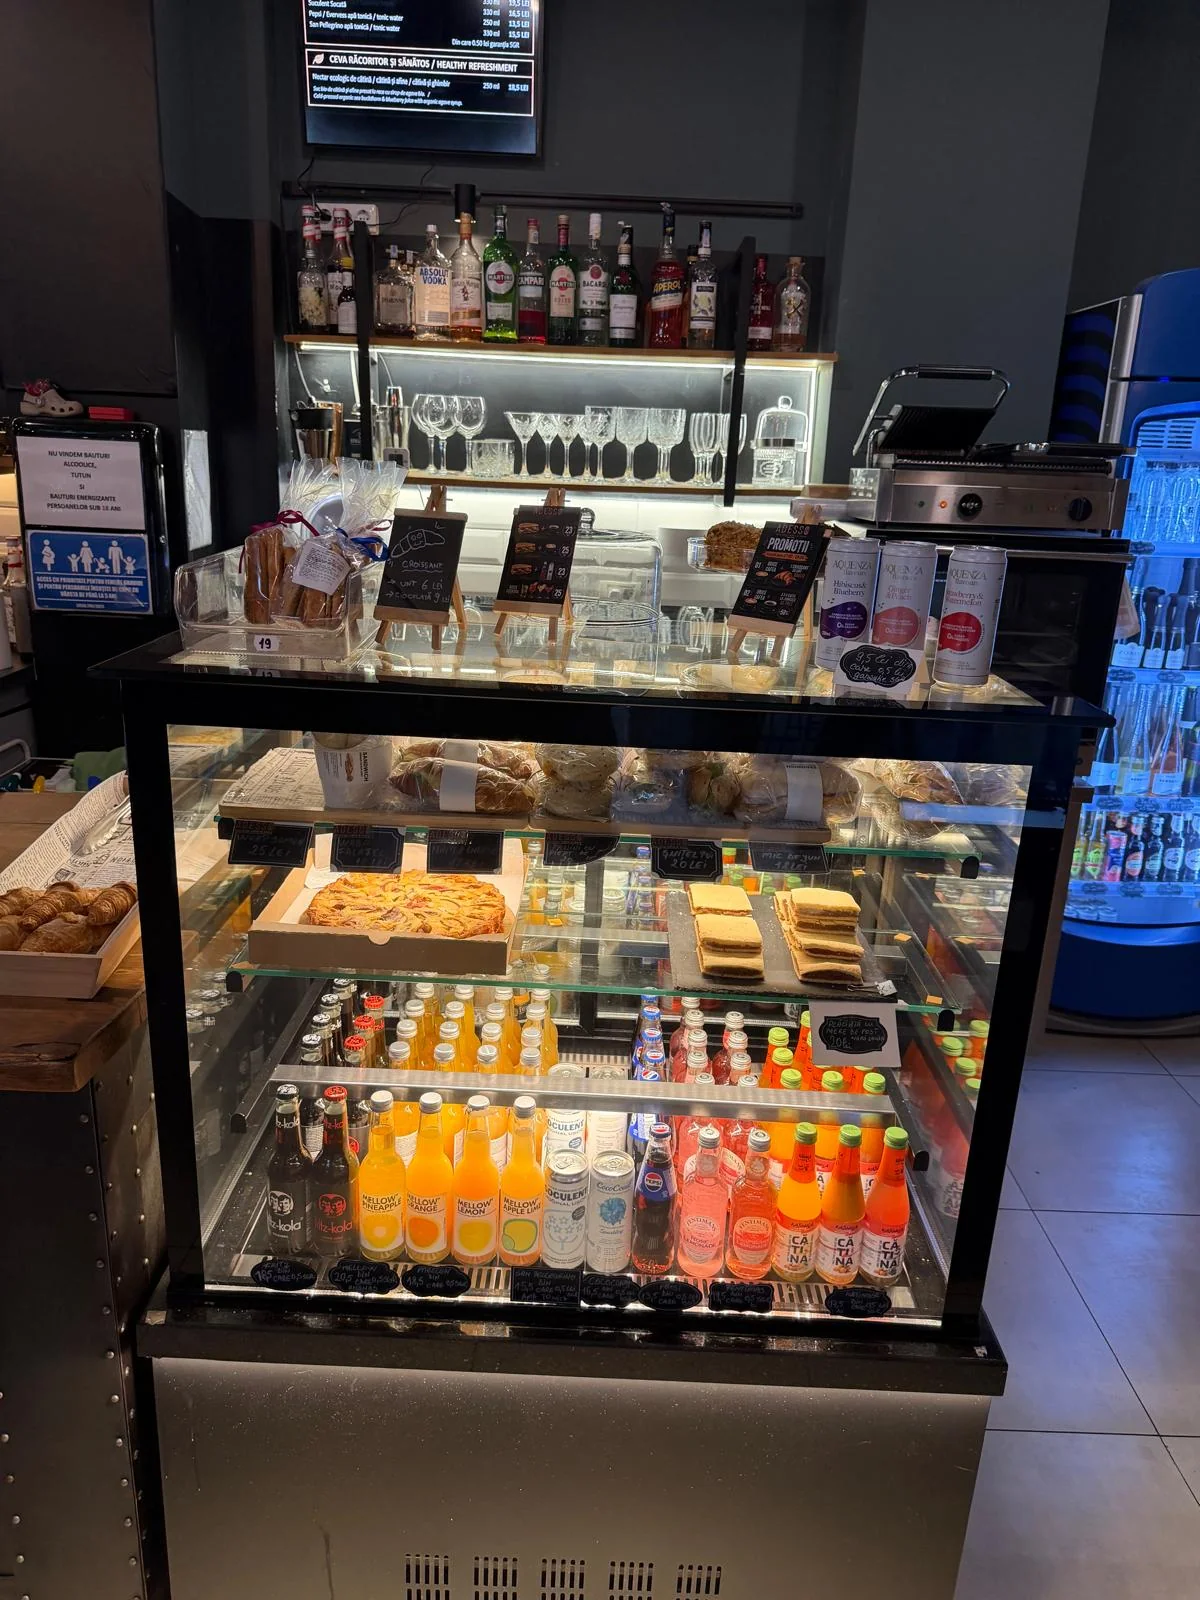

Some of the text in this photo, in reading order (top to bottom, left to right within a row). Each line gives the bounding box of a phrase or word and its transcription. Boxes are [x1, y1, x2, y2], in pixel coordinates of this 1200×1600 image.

[308, 10, 322, 18] Pepsi
[320, 21, 343, 30] Pellegrino
[329, 55, 518, 72] CEVA RĂCORITOR ȘI SĂNĂTOS / HEALTHY REFRESHMENT
[329, 74, 350, 83] ecologic
[420, 268, 448, 277] ABSOLUT
[423, 276, 446, 285] VODKA
[653, 279, 681, 293] APEROL
[767, 537, 810, 553] PROMOTII
[833, 560, 872, 569] AQUENZA
[422, 580, 428, 590] 6
[833, 588, 865, 597] Blueberry
[259, 638, 271, 649] 19
[670, 858, 687, 869] 20
[363, 1194, 396, 1205] MELLOW
[458, 1199, 491, 1209] MELLOW
[504, 1197, 537, 1208] MELLOW
[362, 1200, 401, 1210] PINEAPPLE
[458, 1204, 485, 1215] LEMON
[504, 1204, 525, 1214] APPLE
[792, 1235, 808, 1245] CĂ
[838, 1237, 854, 1247] CĂ
[882, 1239, 899, 1250] CĂ
[790, 1255, 808, 1264] NA
[836, 1257, 854, 1265] NA
[880, 1260, 897, 1268] NA
